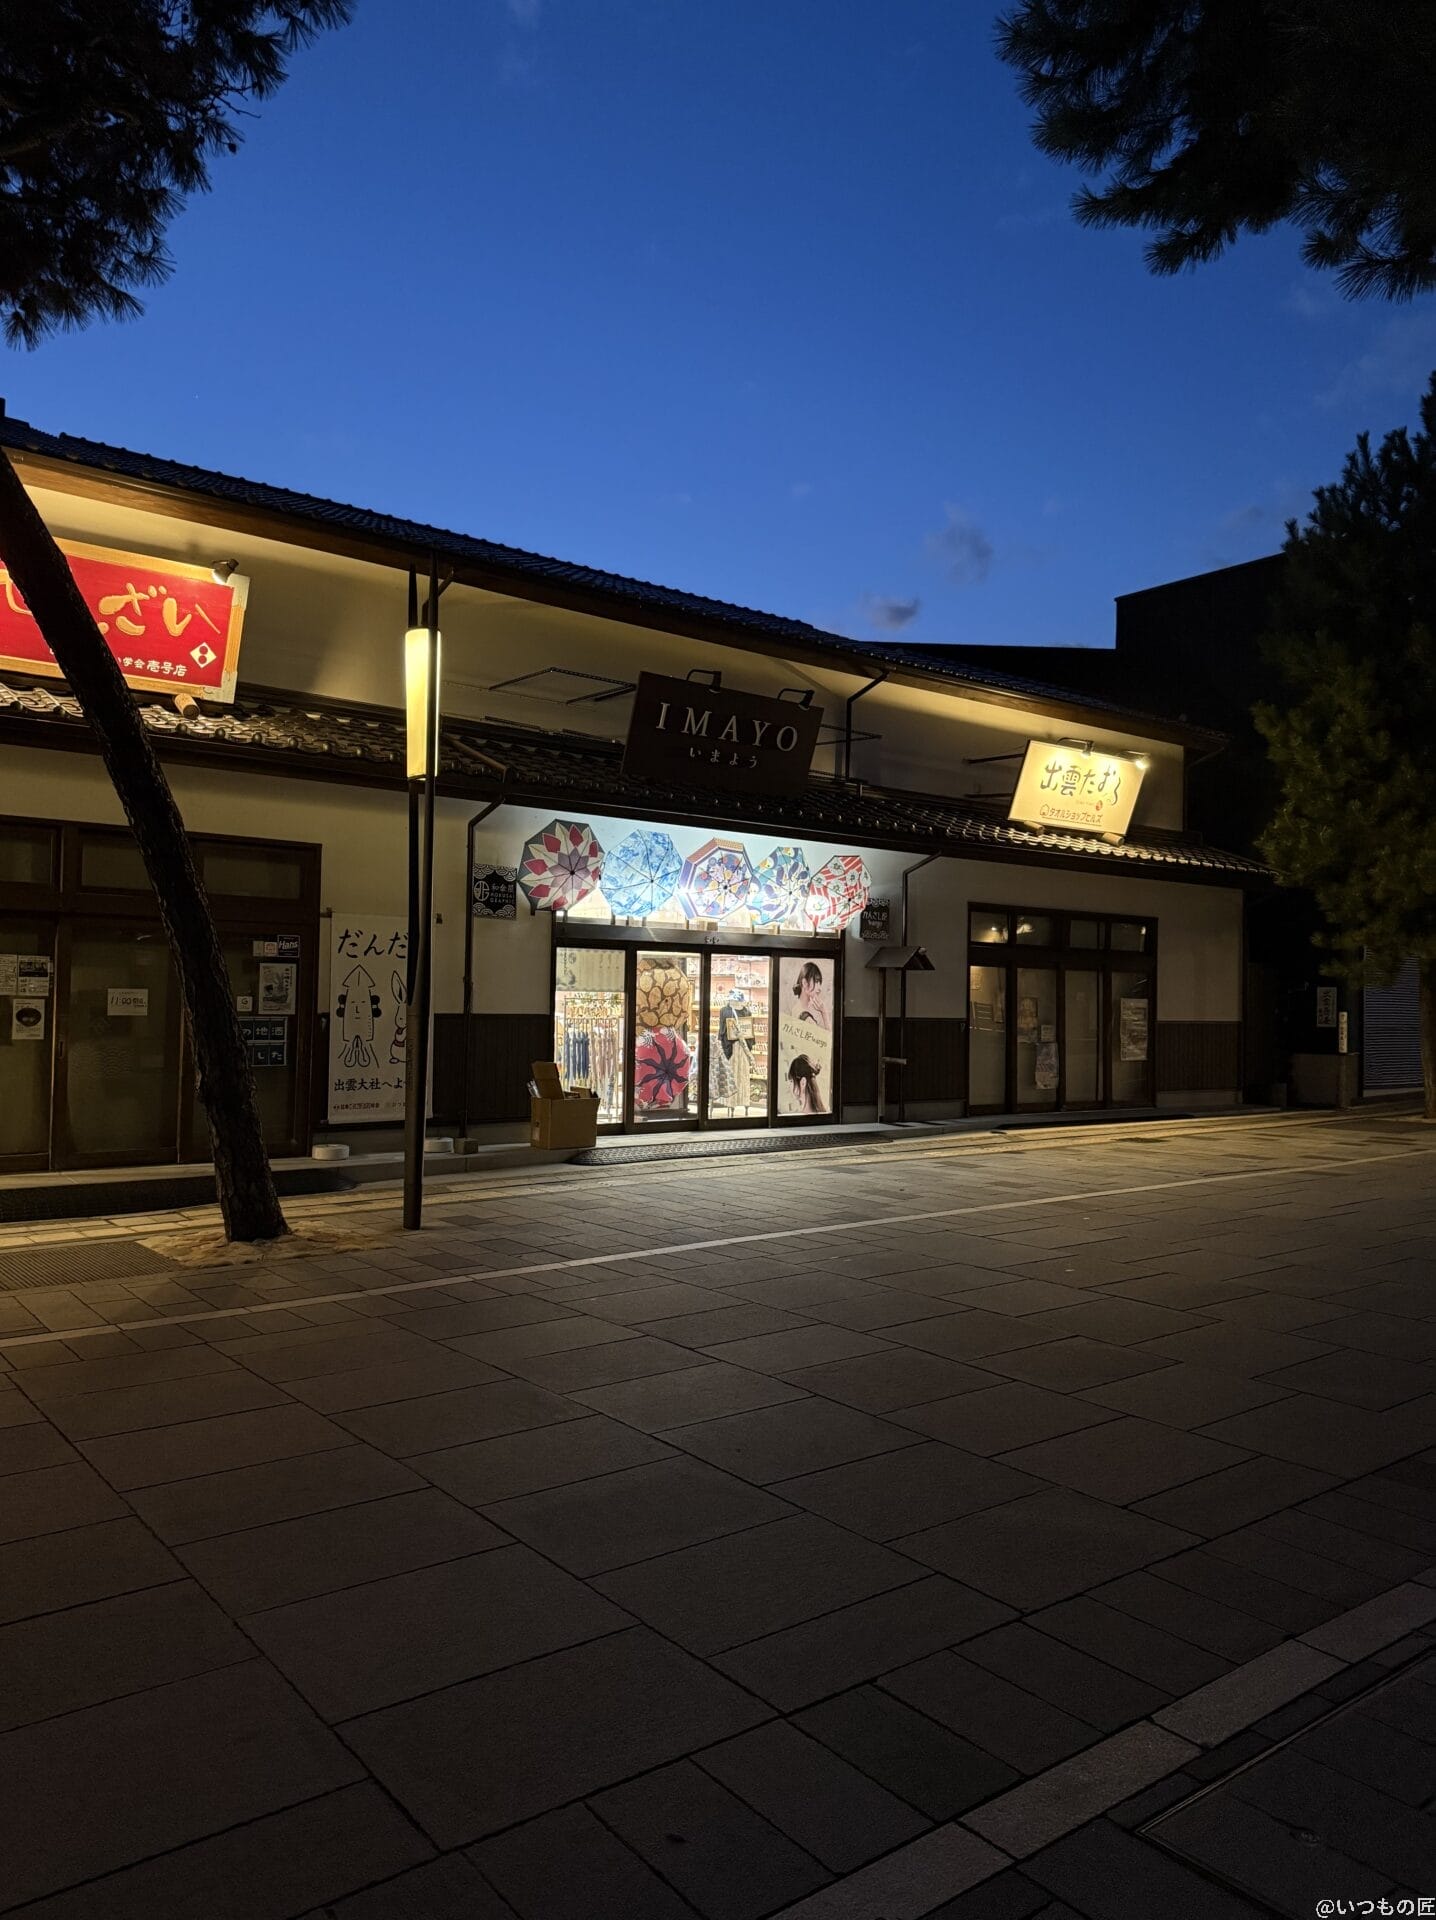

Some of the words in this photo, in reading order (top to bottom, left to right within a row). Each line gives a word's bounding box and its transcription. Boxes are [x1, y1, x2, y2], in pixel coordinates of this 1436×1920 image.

[117, 656, 187, 677] 学会壱号店
[655, 701, 798, 752] IMAYO
[689, 746, 758, 768] いまよう
[334, 1077, 408, 1091] 出雲大社へよ
